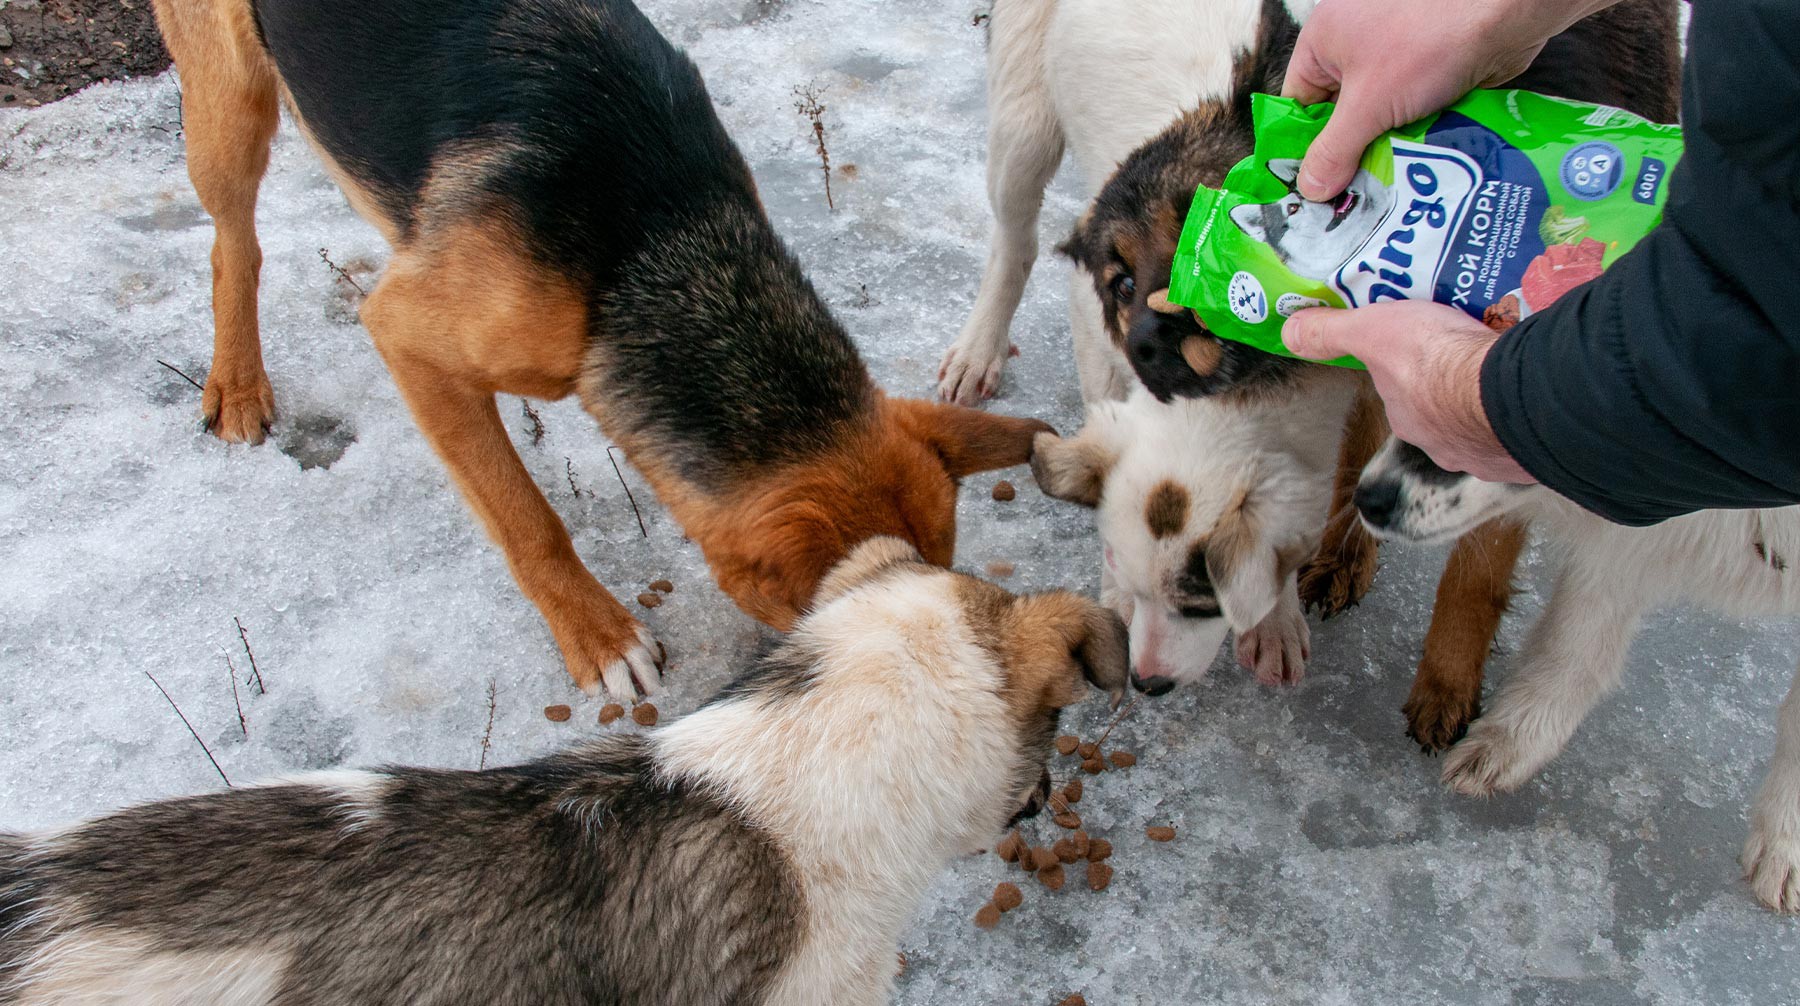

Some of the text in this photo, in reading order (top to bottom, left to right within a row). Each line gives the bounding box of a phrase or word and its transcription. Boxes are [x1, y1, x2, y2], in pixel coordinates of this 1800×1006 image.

[1478, 182, 1512, 282] ПОЛНОРАЦИОННЫЙ
[1507, 187, 1533, 258] С ГОВЯДИНОЙ
[1637, 173, 1656, 199] 600
[1451, 181, 1501, 309] ХОЙ КОРМ
[1484, 184, 1523, 300] ДЛЯ ВЗРОСЛЫХ СОБАК
